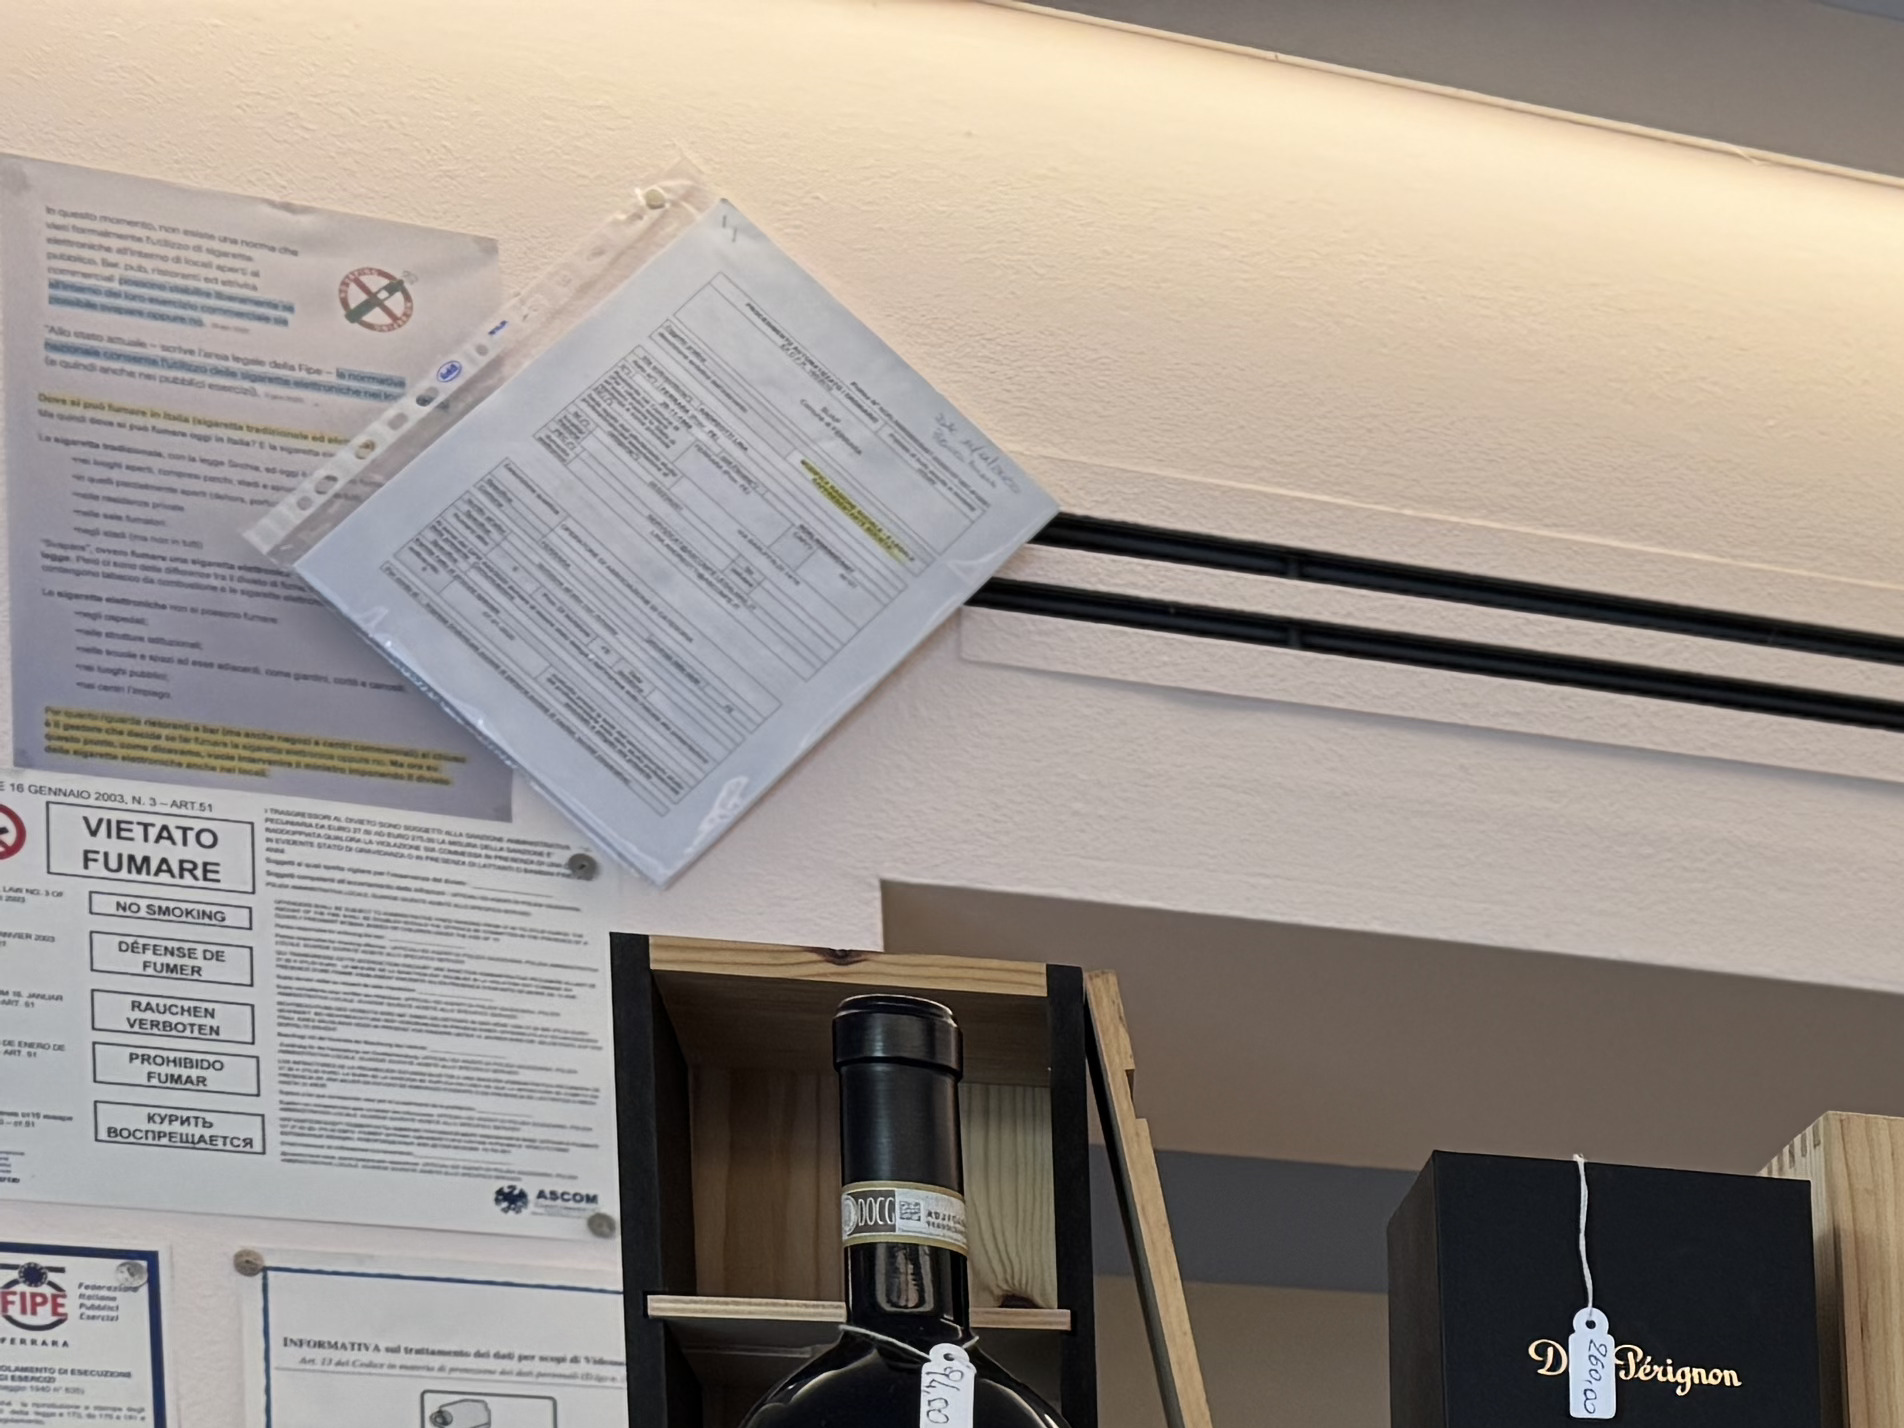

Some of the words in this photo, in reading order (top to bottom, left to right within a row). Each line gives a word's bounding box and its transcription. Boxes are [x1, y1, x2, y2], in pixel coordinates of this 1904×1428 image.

[10, 783, 24, 793] 16
[28, 784, 91, 799] GENNAIO
[82, 816, 218, 849] VIETATO
[83, 850, 221, 883] FUMARE
[116, 901, 140, 914] NO
[146, 904, 226, 922] SMOKING
[118, 938, 198, 960] DÉFENSE
[202, 949, 226, 963] DE
[142, 960, 202, 977] FUMER
[131, 1000, 216, 1019] RAUCHEN
[126, 1017, 220, 1036] VERBOTEN
[129, 1052, 224, 1072] PROHIBIDO
[147, 1071, 208, 1087] FUMAR
[147, 1112, 214, 1129] КУРИТЬ
[106, 1126, 254, 1149] ВОСПРЕЩАЕТСЯ
[535, 1190, 599, 1205] ASCOM
[858, 1197, 896, 1226] DOCG
[1, 1291, 68, 1320] FIPE
[283, 1336, 382, 1354] INFORMATIVA
[1613, 1344, 1743, 1397] Pérignon
